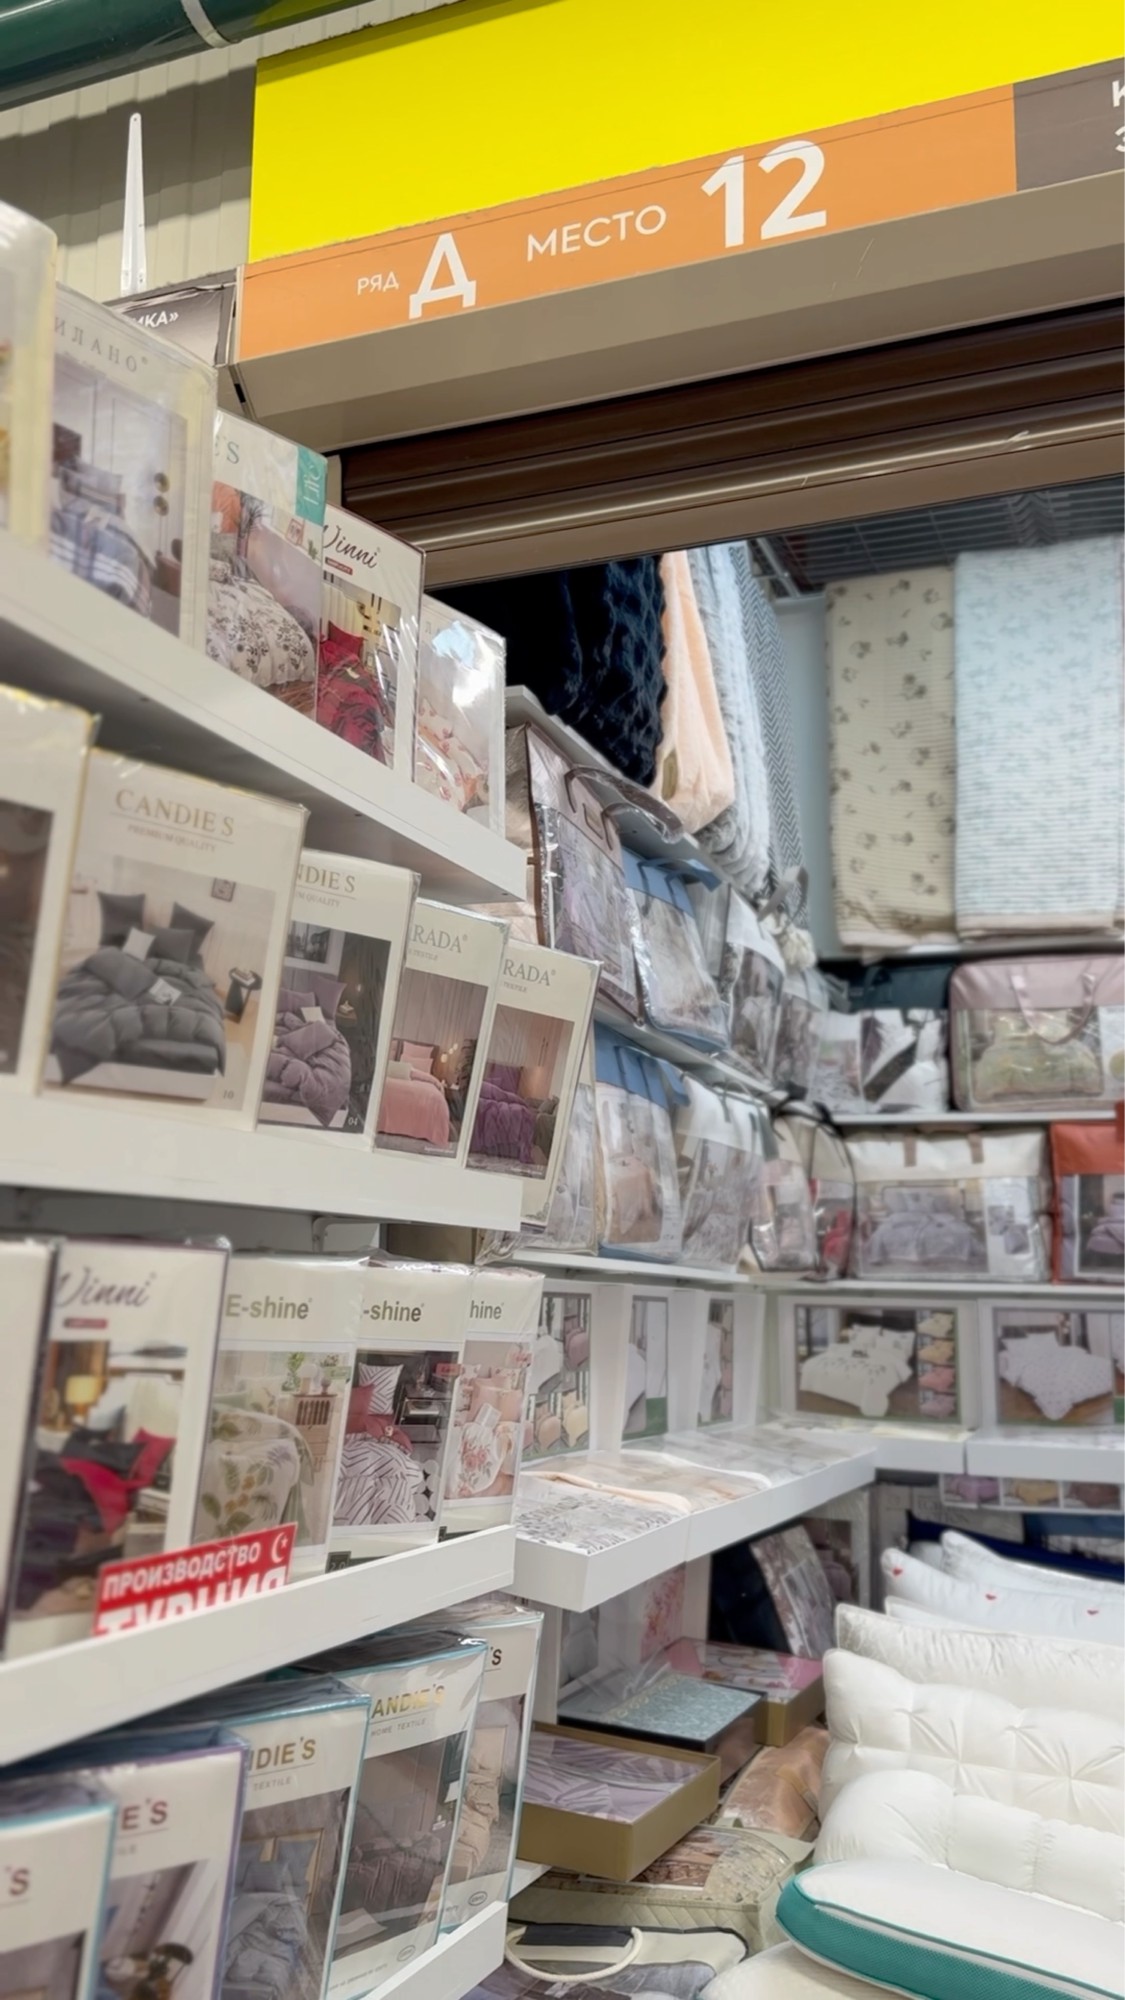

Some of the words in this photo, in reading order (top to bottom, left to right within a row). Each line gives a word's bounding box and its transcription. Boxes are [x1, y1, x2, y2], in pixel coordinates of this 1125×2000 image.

[357, 271, 399, 295] РЯД
[408, 232, 477, 320] Д
[527, 204, 667, 262] МЕСТО
[701, 139, 827, 248] 12
[502, 958, 551, 987] RADA
[225, 1294, 310, 1320] E-shine
[361, 1299, 422, 1322] -shine
[102, 1541, 262, 1600] ПРОИЗВОДСТВО
[253, 1776, 291, 1791] TEXTILE
